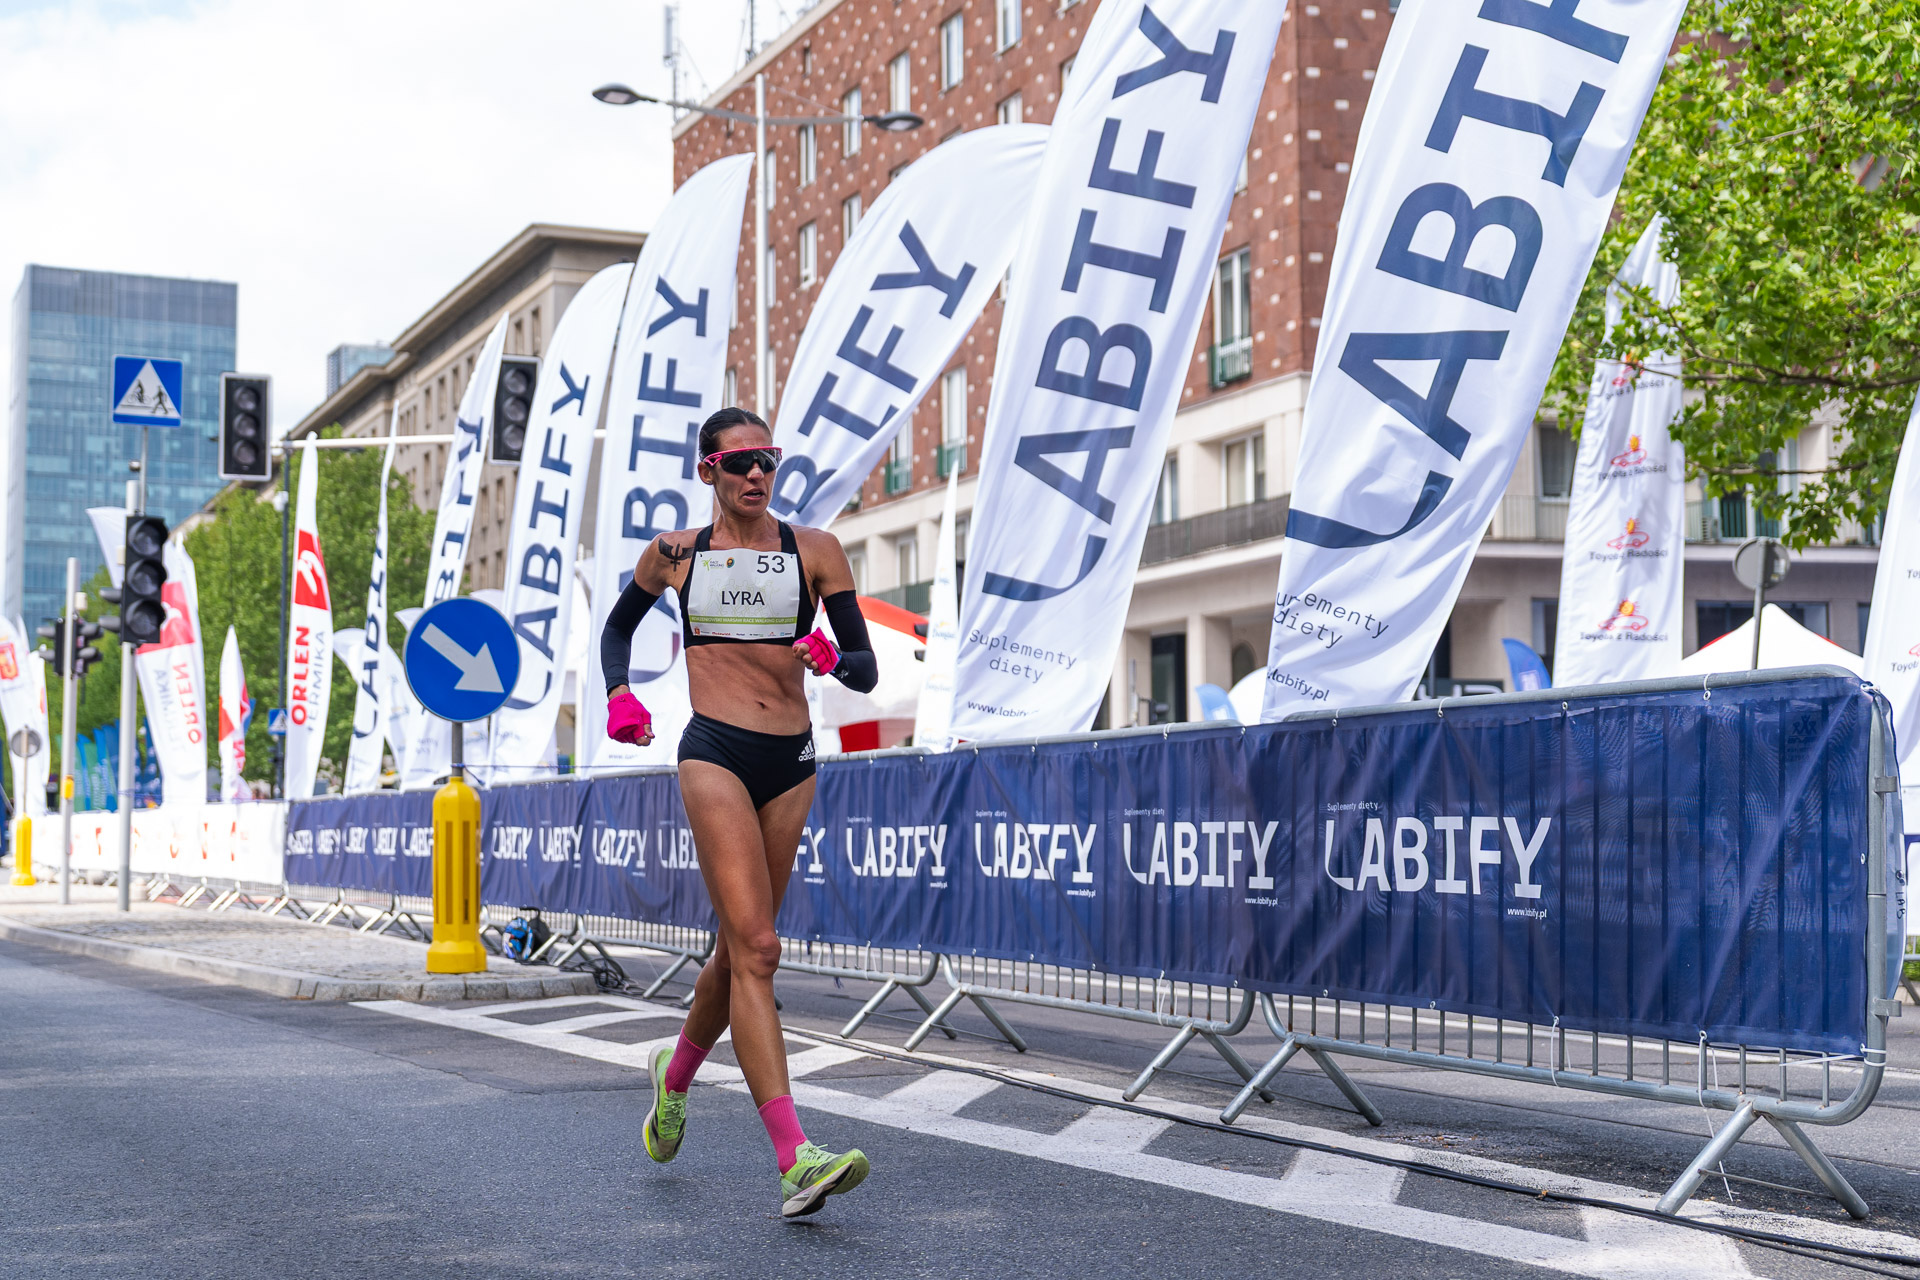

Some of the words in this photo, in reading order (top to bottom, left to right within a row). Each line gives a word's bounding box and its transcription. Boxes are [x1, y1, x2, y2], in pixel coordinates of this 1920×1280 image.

[1285, 0, 1629, 548] LABIF
[982, 4, 1236, 601] LABIFY
[769, 219, 977, 516] BIFY
[756, 555, 785, 574] 53
[721, 591, 765, 606] LYRA
[969, 629, 1077, 670] Suplementy
[1273, 608, 1343, 649] diety
[291, 626, 310, 726] ORLEN
[307, 631, 325, 732] ERMIKA
[989, 657, 1044, 684] diety
[1358, 801, 1378, 811] diety
[846, 824, 948, 877] LABIFY
[975, 822, 1097, 883] LABIFY
[1123, 821, 1279, 890] LABIFY
[1325, 816, 1552, 899] LABIFY
[1244, 897, 1279, 906] www.labify.pl
[1507, 907, 1548, 920] www.labify.pl
